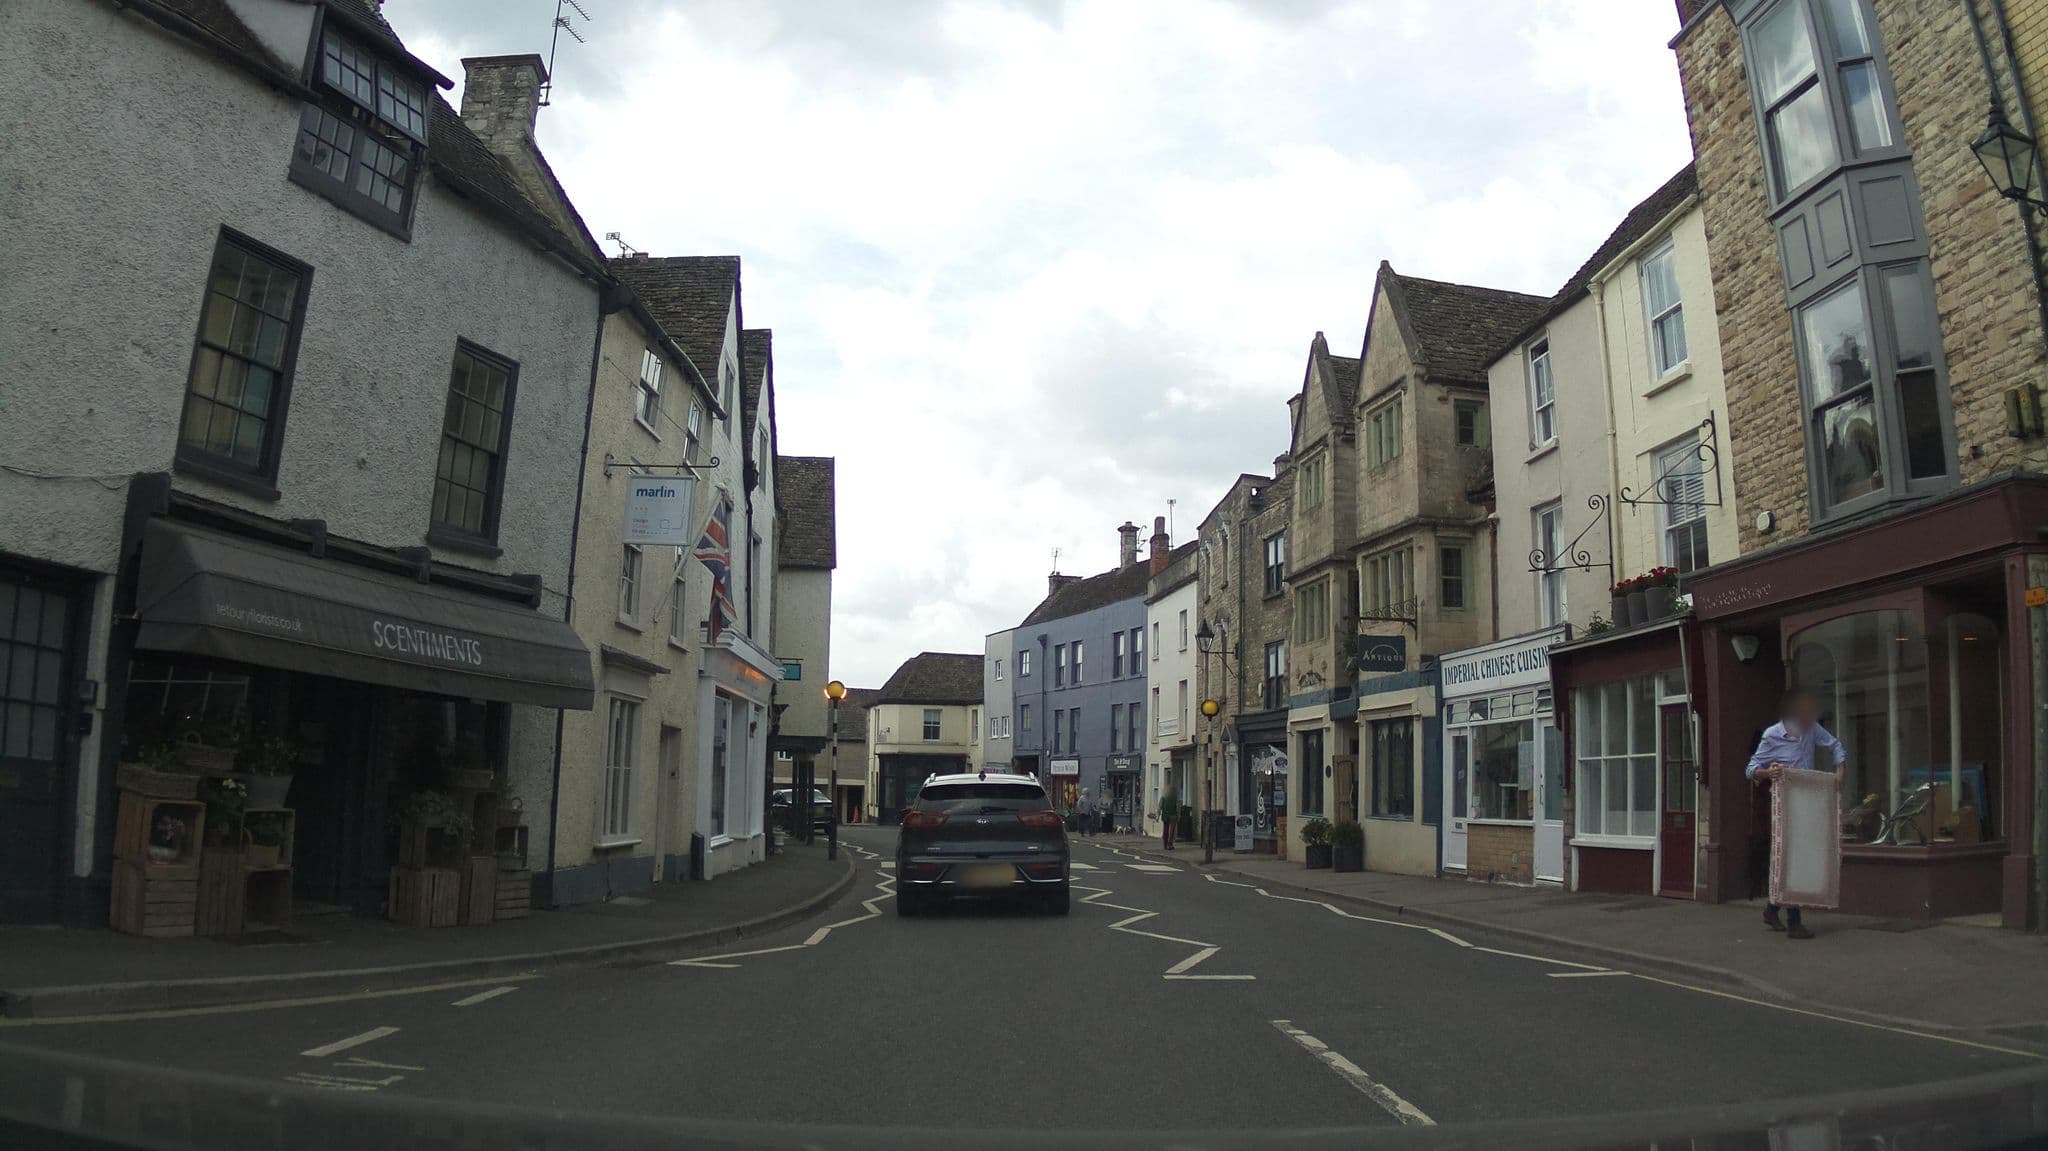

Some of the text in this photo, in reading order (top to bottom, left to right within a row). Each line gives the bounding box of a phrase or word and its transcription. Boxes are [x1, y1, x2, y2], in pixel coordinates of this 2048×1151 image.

[636, 486, 676, 498] marlin
[372, 620, 482, 666] SCENTIMENTS
[1444, 645, 1549, 686] IMPERIAL CHINESE CUISIN
